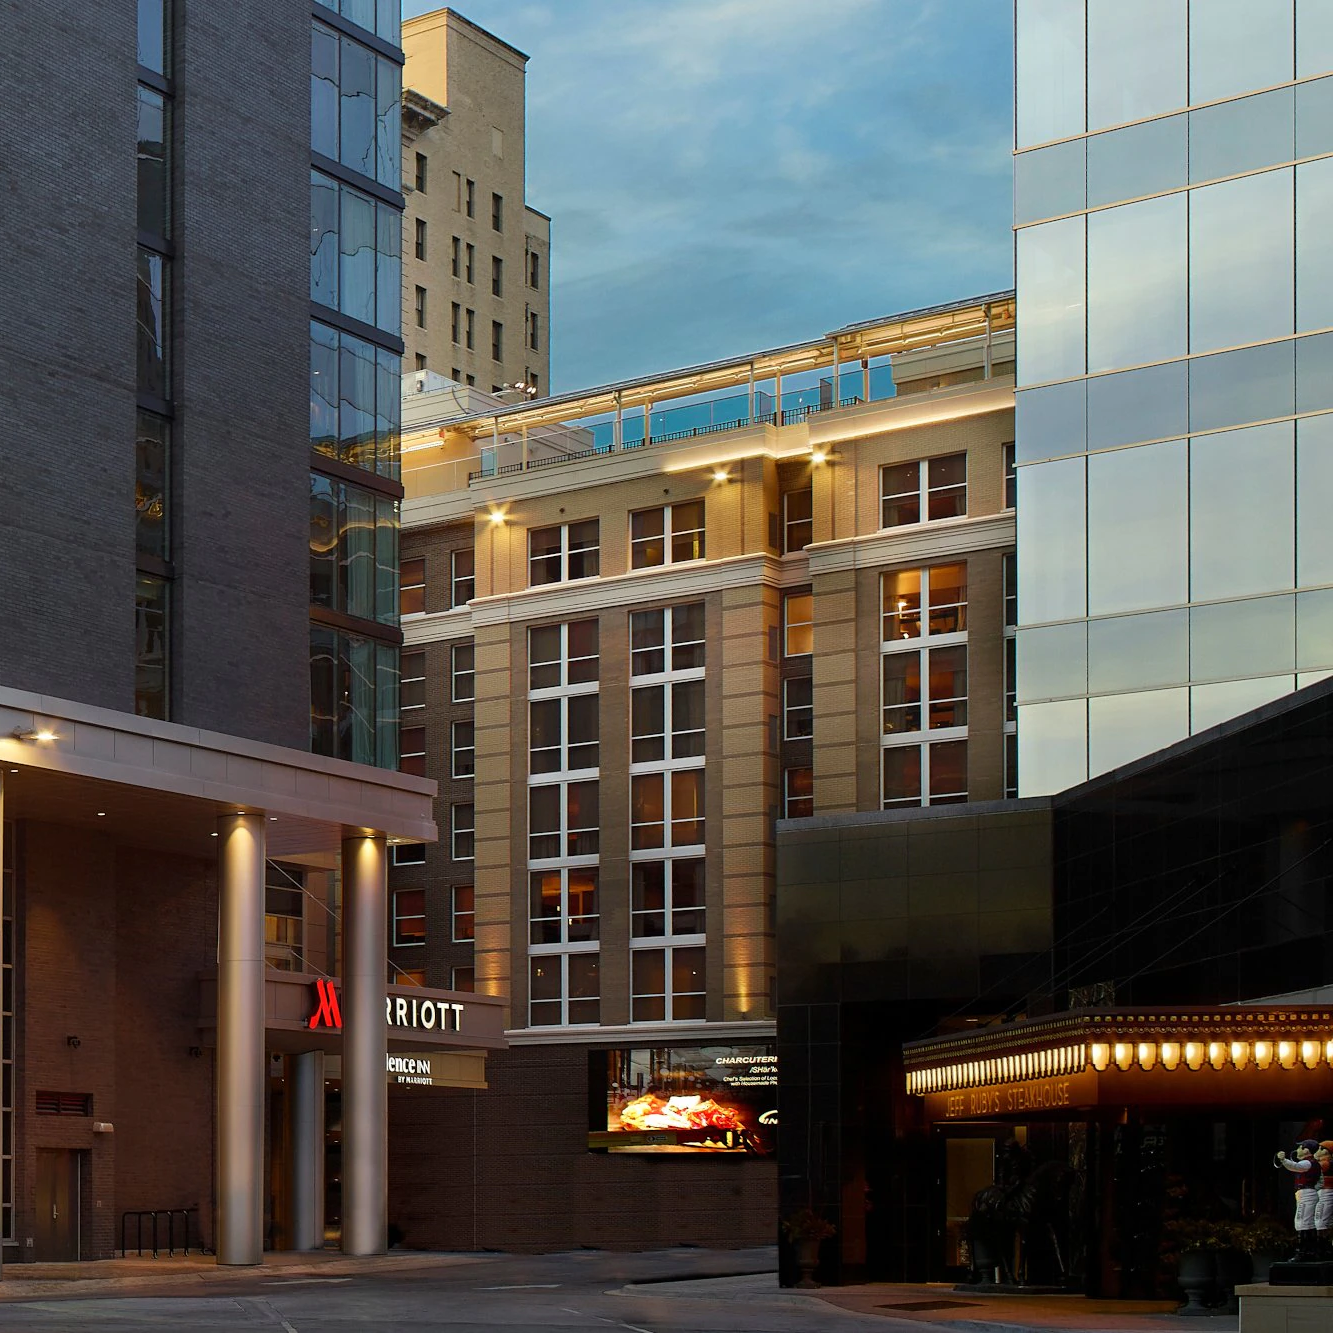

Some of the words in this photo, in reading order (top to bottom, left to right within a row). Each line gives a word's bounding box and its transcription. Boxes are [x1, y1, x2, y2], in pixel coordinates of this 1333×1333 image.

[397, 1075, 405, 1083] BY
[406, 1076, 433, 1085] MARRIOTT
[945, 1095, 964, 1117] JEFF
[970, 1091, 1000, 1114] RUBY'S
[1007, 1082, 1070, 1111] STEAKHOUSE
